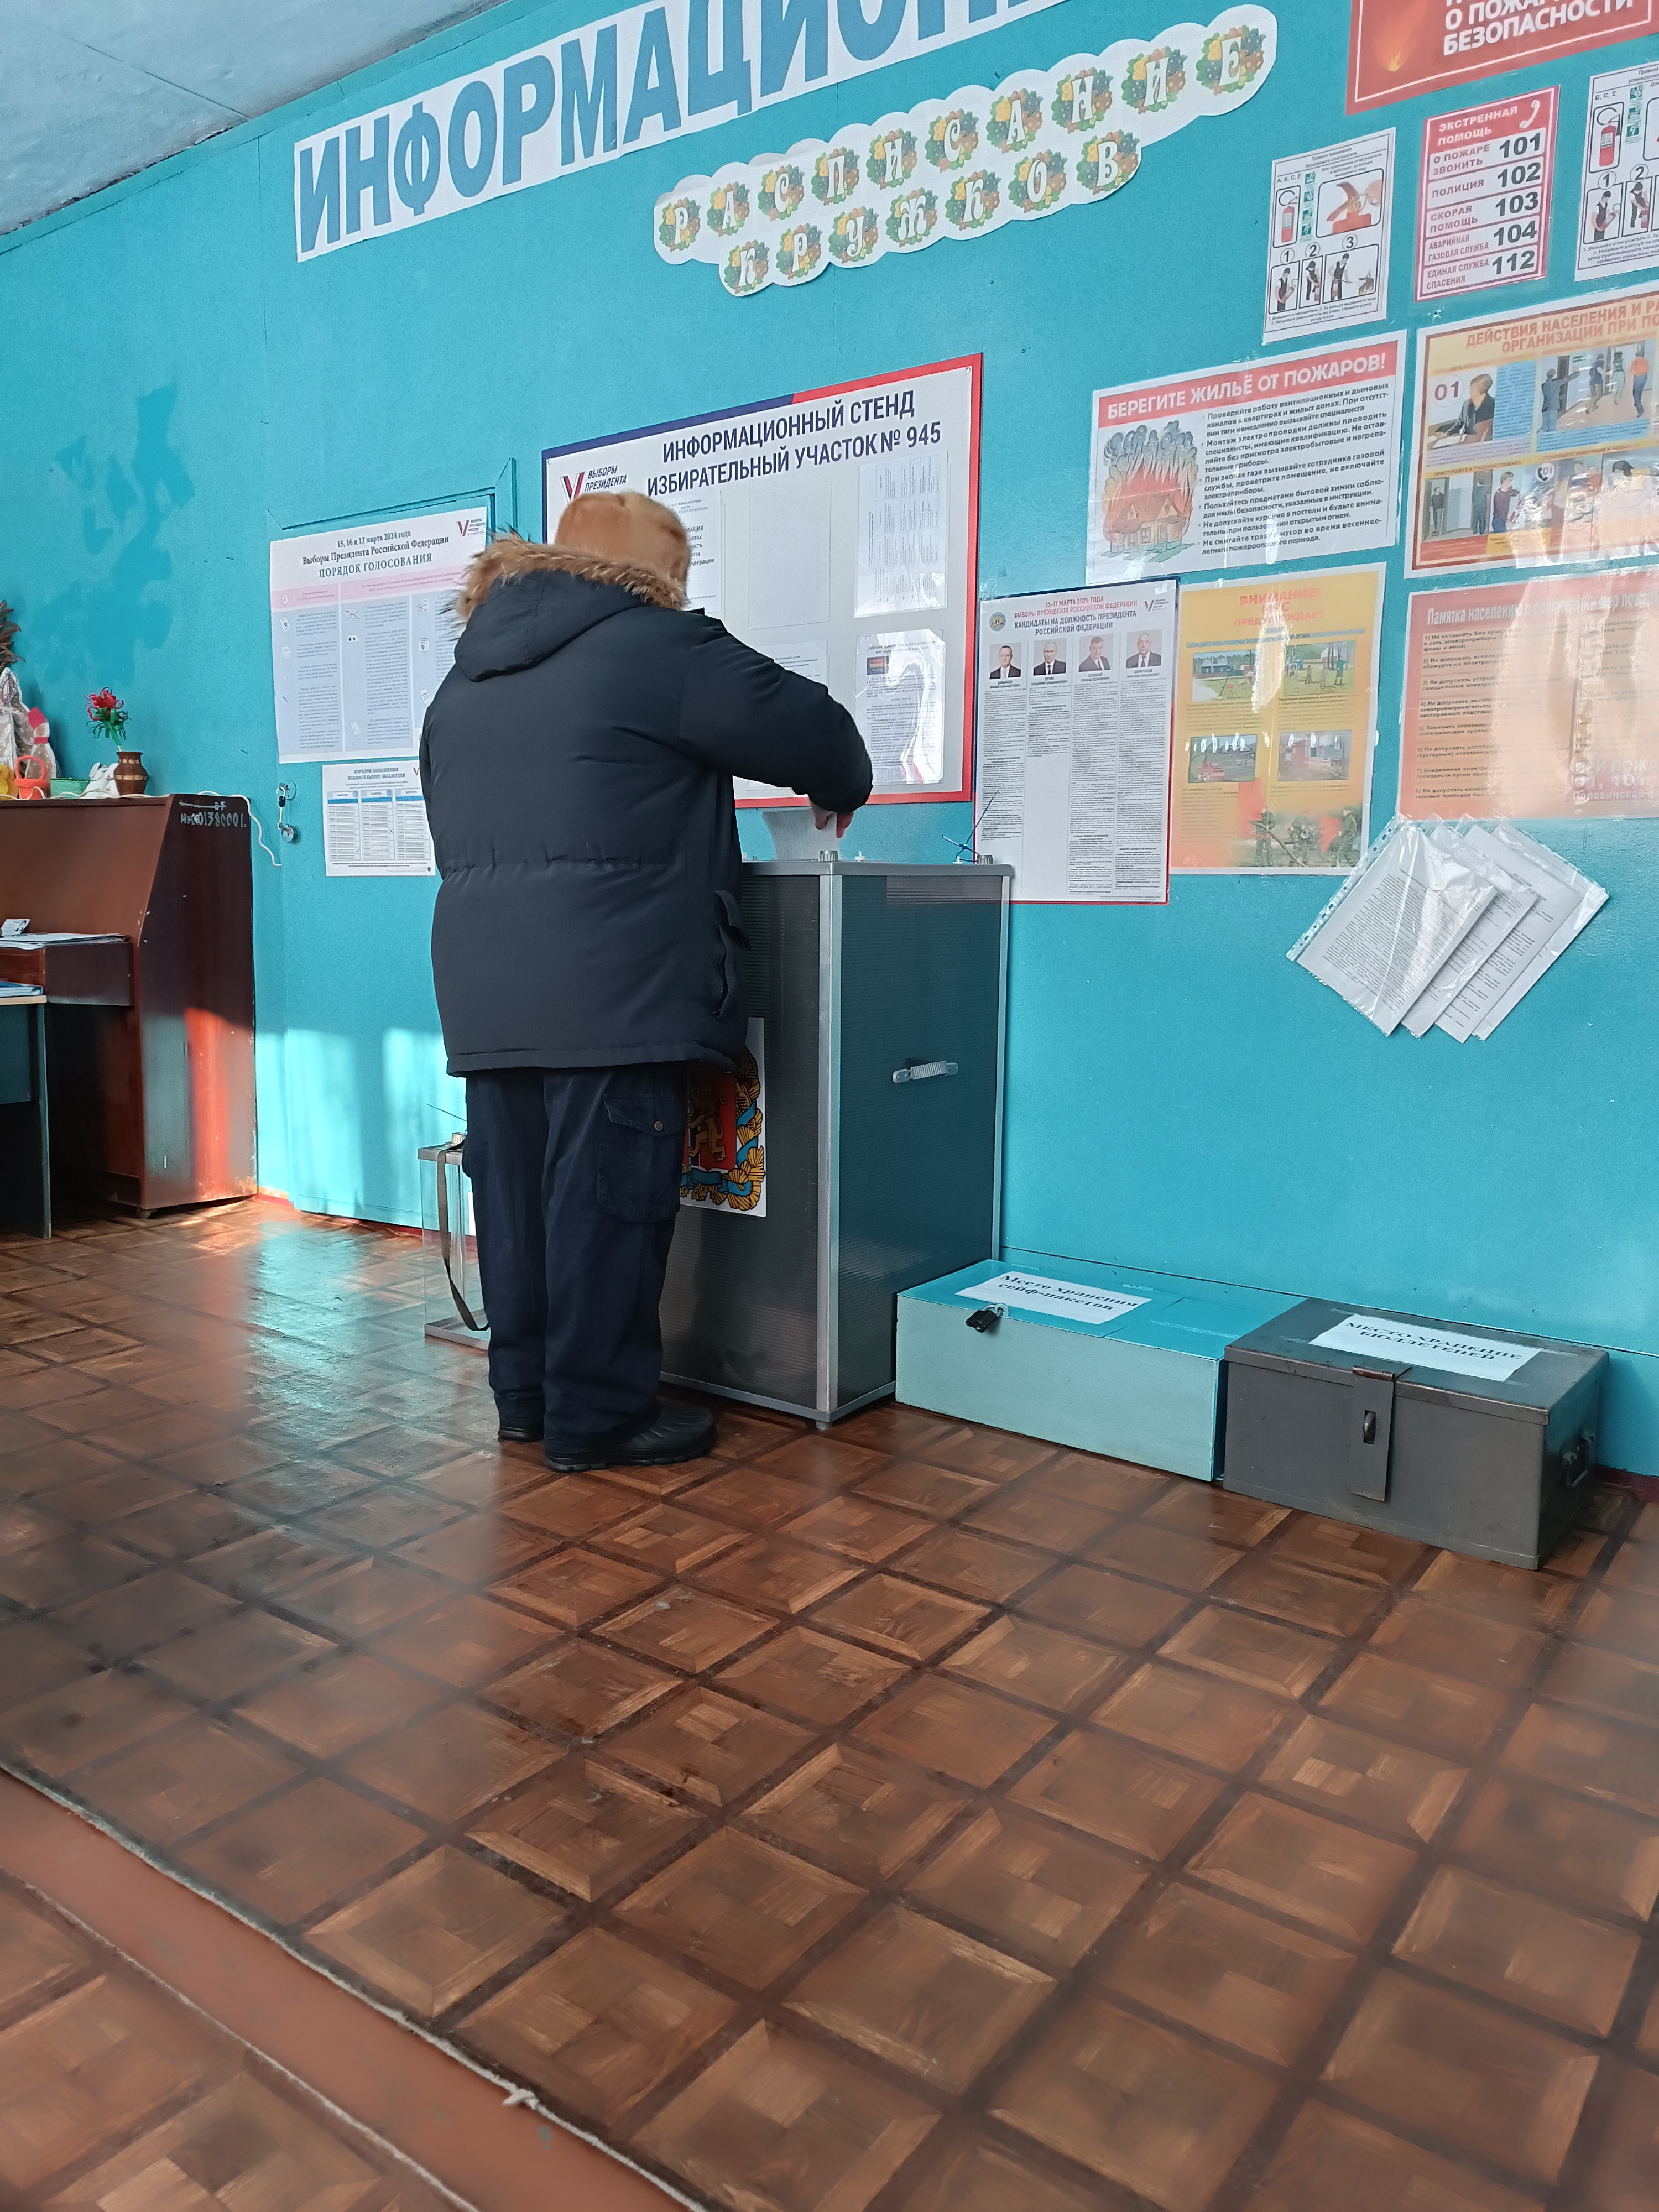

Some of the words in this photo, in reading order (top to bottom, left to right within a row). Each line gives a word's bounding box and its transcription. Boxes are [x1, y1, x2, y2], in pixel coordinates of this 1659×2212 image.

[1445, 8, 1462, 30] О
[299, 0, 1030, 253] ИНФОРМАЦИ
[1439, 106, 1517, 132] ЭКСТРЕННАЯ
[675, 36, 1243, 246] РАСПИСАНИЕ
[1438, 127, 1491, 146] ПОМОЩЬ
[1499, 132, 1541, 158] 101
[1444, 144, 1490, 161] ПОЖАРЕ
[1433, 159, 1483, 175] ЗВОНИТЬ
[1498, 162, 1541, 187] 102
[1635, 166, 1644, 181] 2
[1432, 179, 1484, 198] ПОЛИЦИЯ
[1603, 174, 1610, 187] 1
[1431, 205, 1472, 221] СКОРАЯ
[1495, 191, 1538, 216] 103
[739, 140, 1119, 287] КРУЖКОВ
[1430, 216, 1478, 233] ПОМОЩЬ
[1494, 220, 1537, 246] 104
[1309, 244, 1317, 257] 2
[1346, 236, 1354, 249] 3
[1429, 234, 1469, 249] АВАРИЙНАЯ
[1284, 250, 1289, 262] 1
[1428, 249, 1458, 261] ГАЗОВАЯ
[1460, 242, 1489, 254] СЛУЖБА
[1428, 265, 1456, 278] ЕДИНАЯ
[1459, 259, 1489, 272] СЛУЖБА
[1493, 250, 1535, 274] 112
[1427, 275, 1465, 289] СПАСЕНИЯ
[1467, 323, 1537, 349] ДЕЙСТВИЯ
[1542, 305, 1627, 335] НАСЕЛЕНИЯ
[1632, 302, 1641, 315] И
[1502, 325, 1603, 354] ОРГАНИЗАЦИИ
[1608, 319, 1636, 336] ПРИ
[1108, 390, 1185, 419] БЕРЕГИТЕ
[1190, 374, 1252, 405] ЖИЛЬЁ
[1258, 373, 1279, 392] ОТ
[1284, 353, 1385, 387] ПОЖАРОВ!
[1434, 380, 1459, 401] 01
[1253, 403, 1277, 413] работу
[1280, 391, 1344, 407] вентиляционных
[1352, 383, 1389, 395] дымовых
[1244, 411, 1282, 422] квартирах
[1290, 405, 1314, 414] жилых
[1280, 413, 1319, 425] вызывайте
[664, 401, 844, 463] ИНФОРМАЦИОННЫЙ
[850, 390, 915, 425] СТЕНД
[1207, 437, 1236, 447] Монтаж
[1308, 420, 1340, 431] должны
[1343, 413, 1386, 425] проводить
[1291, 427, 1350, 441] квалификацию.
[881, 429, 900, 453] №
[907, 421, 941, 448] 945
[1280, 437, 1344, 452] электробытовые
[647, 450, 789, 497] ИЗБИРАТЕЛЬНЫЙ
[795, 440, 877, 469] УЧАСТОК
[1264, 462, 1306, 473] вызывайте
[1308, 456, 1351, 467] сотрудника
[1353, 448, 1384, 460] газовой
[588, 465, 618, 479] ВЫБОРЫ
[1236, 476, 1280, 487] проветрите
[1340, 460, 1384, 471] включайте
[585, 474, 627, 492] ПРЕЗИДЕНТА
[1250, 492, 1294, 504] предметами
[1296, 486, 1328, 497] бытовой
[1329, 502, 1354, 511] будьте
[1290, 516, 1326, 525] открытым
[1316, 524, 1340, 532] время
[1343, 519, 1381, 528] весеннее-
[366, 535, 383, 545] марта
[384, 533, 397, 541] 2024
[398, 530, 411, 539] года
[303, 555, 330, 565] Выборы
[331, 550, 369, 561] Президента
[371, 541, 410, 555] Российской
[411, 536, 449, 549] Федерации
[319, 564, 361, 578] ПОРЯДОК
[363, 553, 432, 572] ГОЛОСОВАНИЯ
[690, 558, 714, 566] едерации
[1070, 603, 1104, 612] РОССИЙСКОЙ
[1105, 600, 1137, 609] ФЕДЕРАЦИИ
[1015, 619, 1050, 629] КАНДИДАТЫ
[1060, 615, 1096, 625] ДОЛЖНОСТЬ
[1098, 610, 1136, 620] ПРЕЗИДЕНТА
[1427, 608, 1465, 625] Памятка
[1035, 625, 1074, 635] РОССИЙСКОЙ
[1076, 622, 1113, 632] ФЕДЕРАЦИИ
[999, 1283, 1114, 1311] сейф-пакетов
[1000, 1275, 1051, 1290] Место
[1055, 1287, 1138, 1307] хранения
[1345, 1322, 1411, 1338] МЕСТО
[1416, 1336, 1522, 1359] ХРАНЕНИЕ
[1359, 1332, 1496, 1360] БЮЛЛЕТЕНЕЙ
